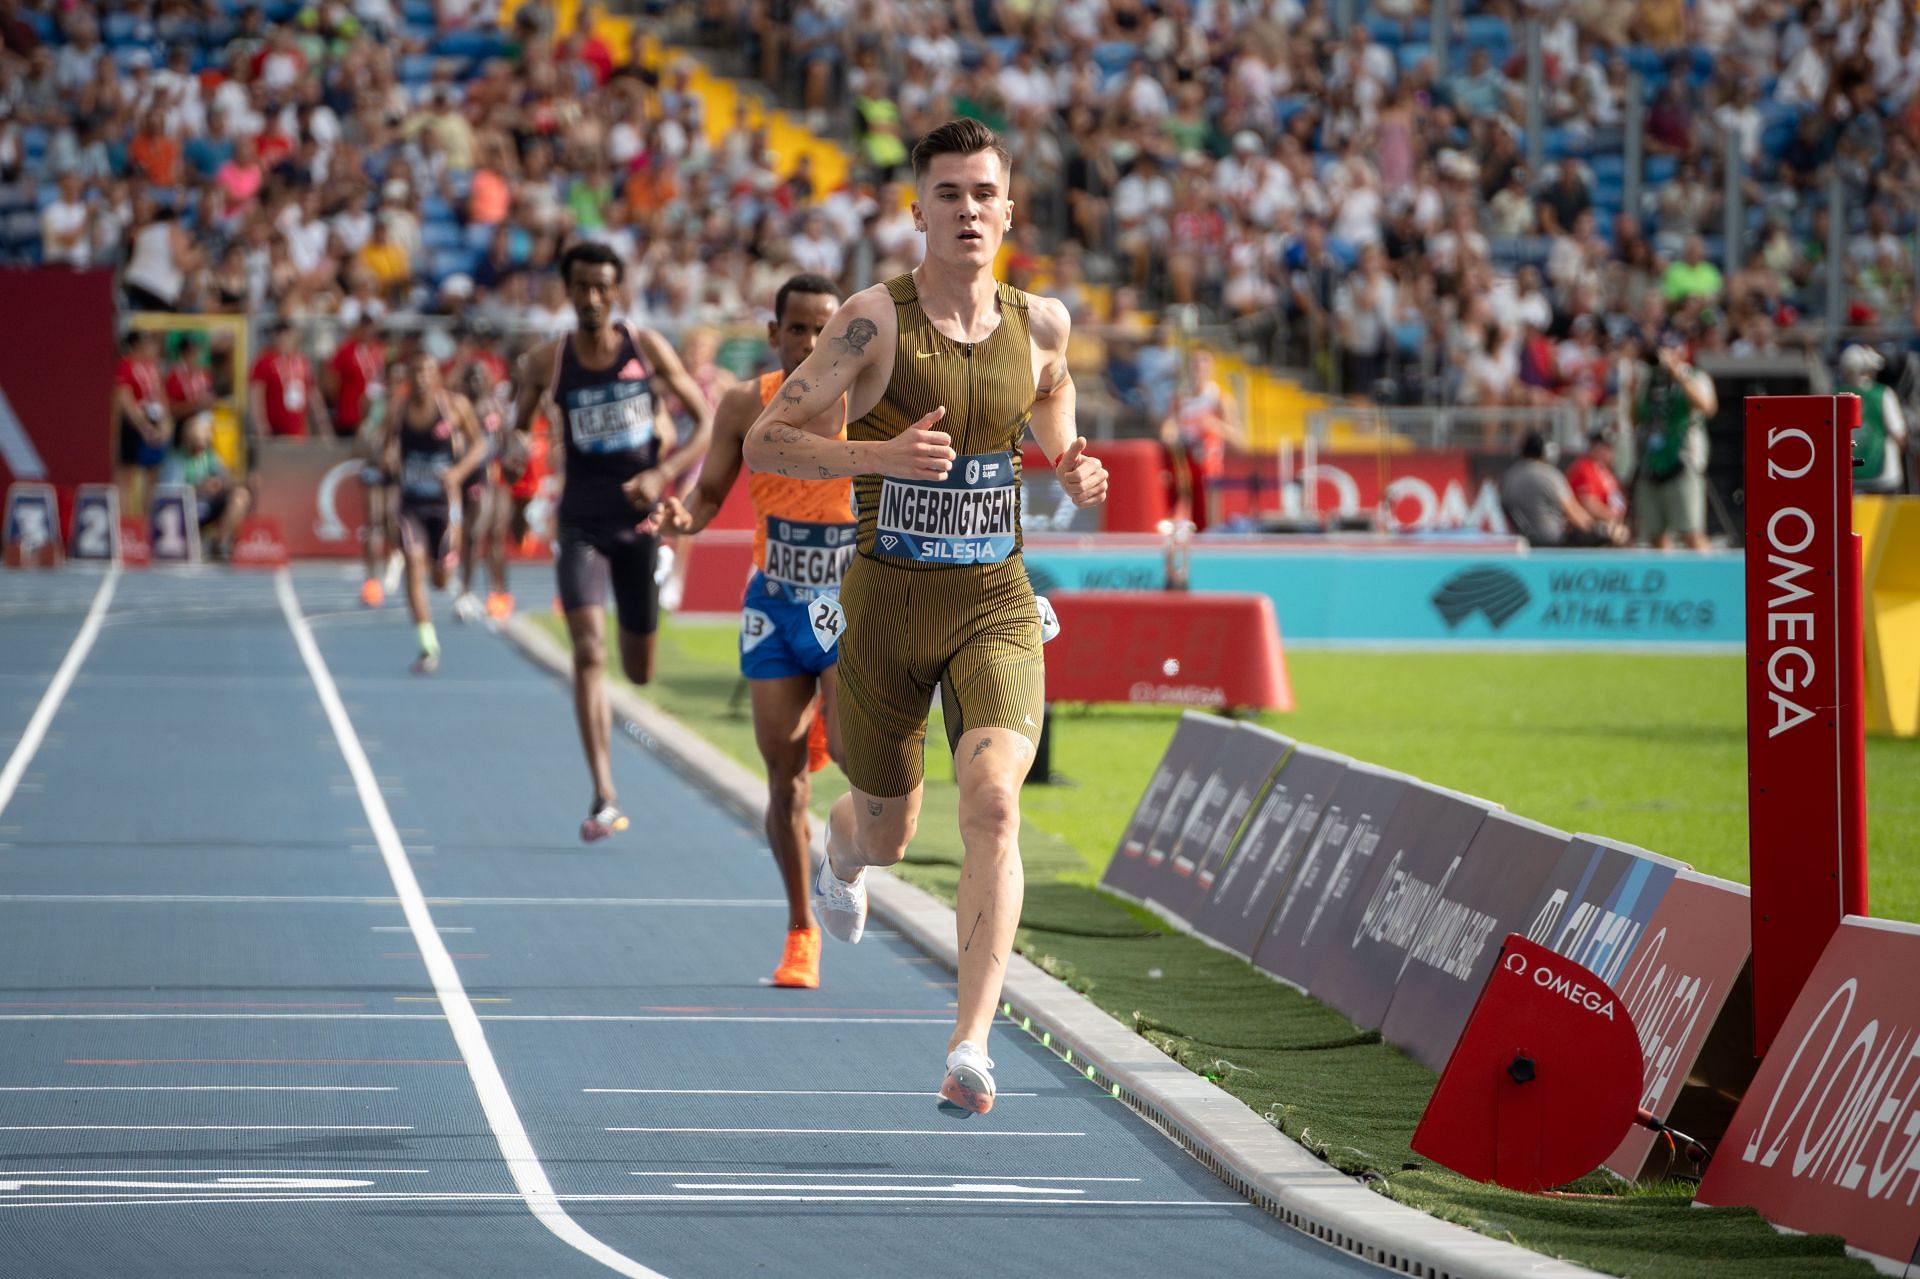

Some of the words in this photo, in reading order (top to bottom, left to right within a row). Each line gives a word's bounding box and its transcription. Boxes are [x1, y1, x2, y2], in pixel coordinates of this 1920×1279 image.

[79, 503, 108, 555] 2
[156, 504, 185, 556] 1
[881, 483, 1012, 536] INGEBRIGTSEN
[921, 541, 996, 559] SILESIA
[1549, 569, 1667, 594] WORLD
[744, 614, 764, 637] 13
[814, 603, 838, 636] 24
[1543, 600, 1716, 629] ATHLETICS
[1767, 506, 1817, 739] OMEGA
[1533, 967, 1615, 1021] OMEGA
